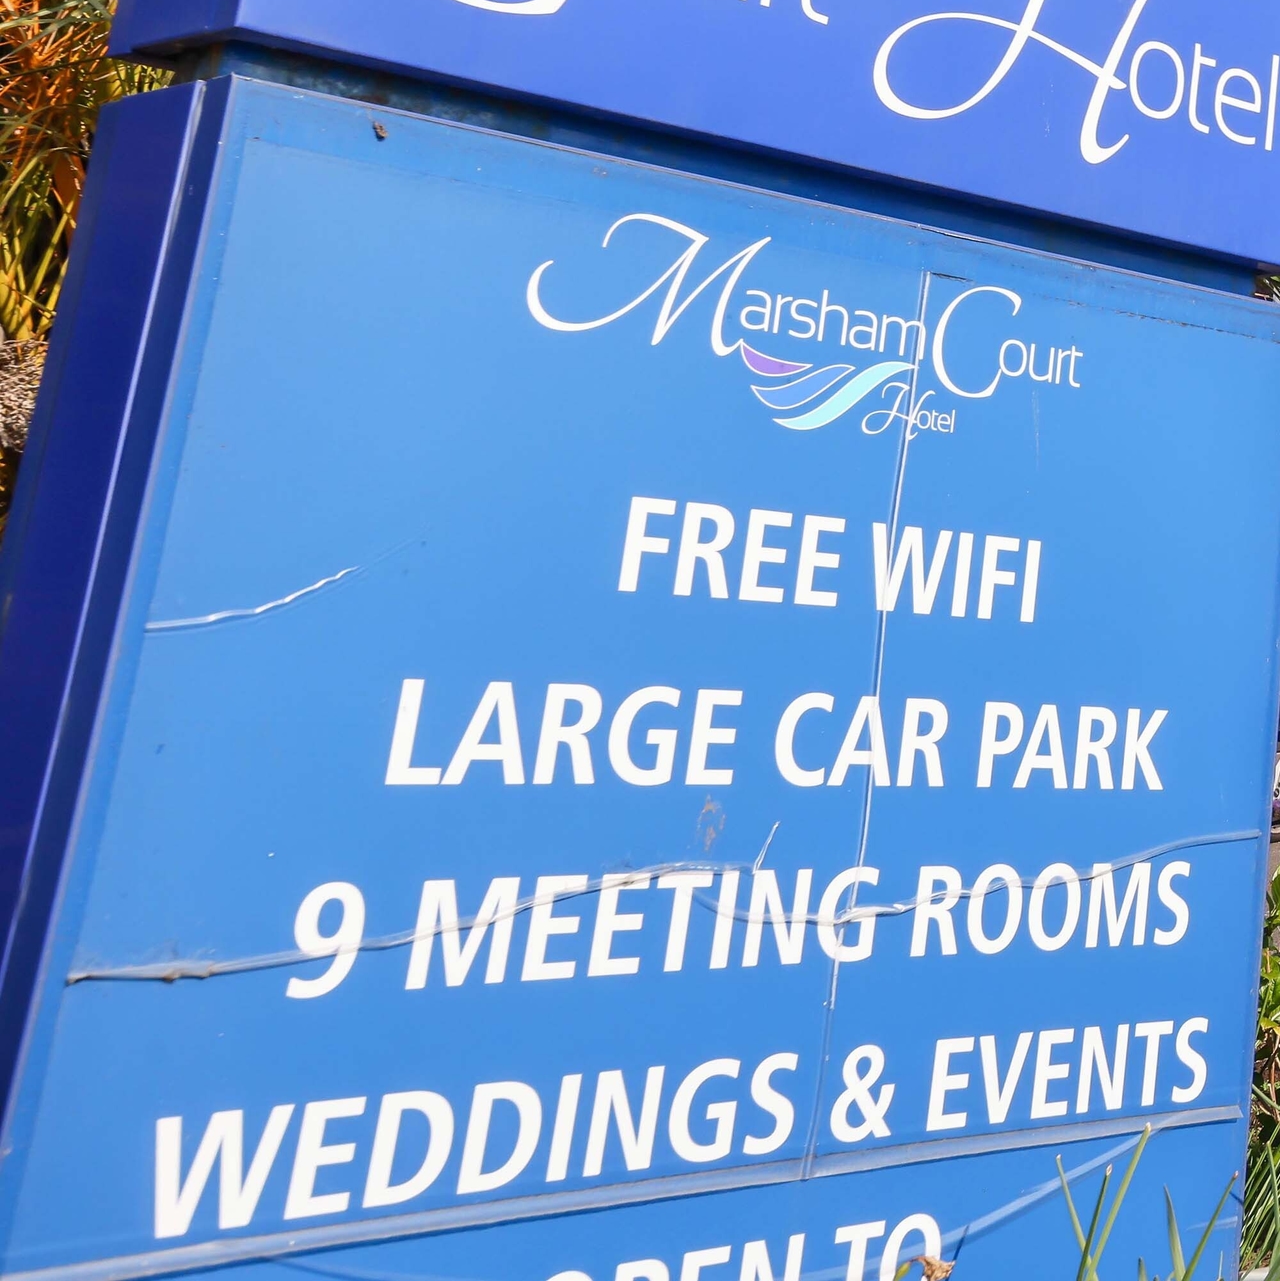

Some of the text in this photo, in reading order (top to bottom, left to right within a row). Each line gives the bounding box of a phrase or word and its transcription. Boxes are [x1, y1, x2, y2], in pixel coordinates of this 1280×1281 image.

[527, 213, 1083, 398] Marsham Court
[862, 382, 955, 440] Hotel
[618, 496, 1042, 623] FREE WIFI
[385, 678, 1169, 791] LARGE CAR PARK
[286, 860, 1191, 999] 9 MEETING ROOMS
[154, 1017, 1209, 1239] WEDDINGS & EVENTS
